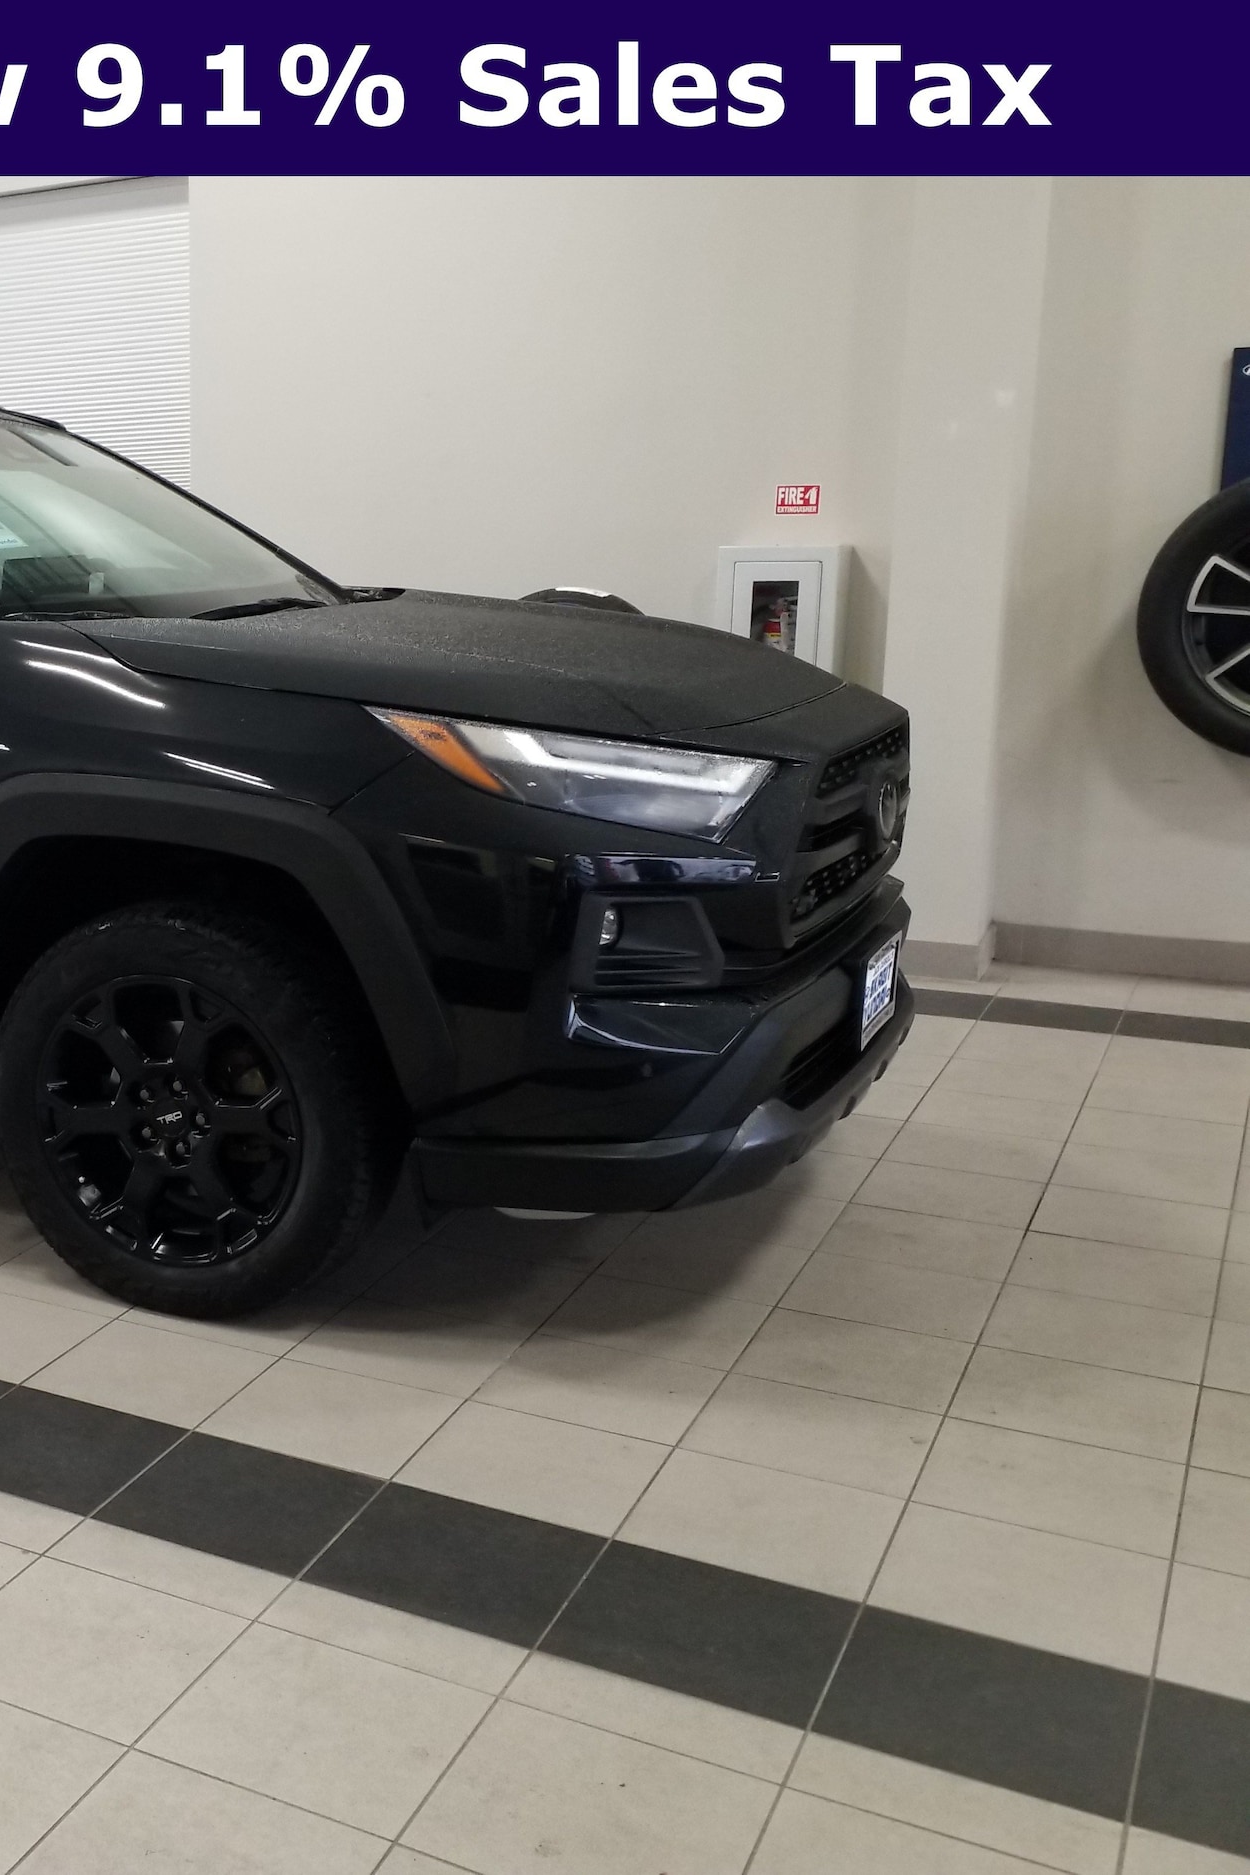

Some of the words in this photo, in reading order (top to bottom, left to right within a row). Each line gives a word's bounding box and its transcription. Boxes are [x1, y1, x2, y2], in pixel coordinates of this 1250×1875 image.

[777, 487, 805, 505] FIRE
[777, 505, 817, 513] EXTINGUISHER
[156, 1111, 183, 1124] TRD
